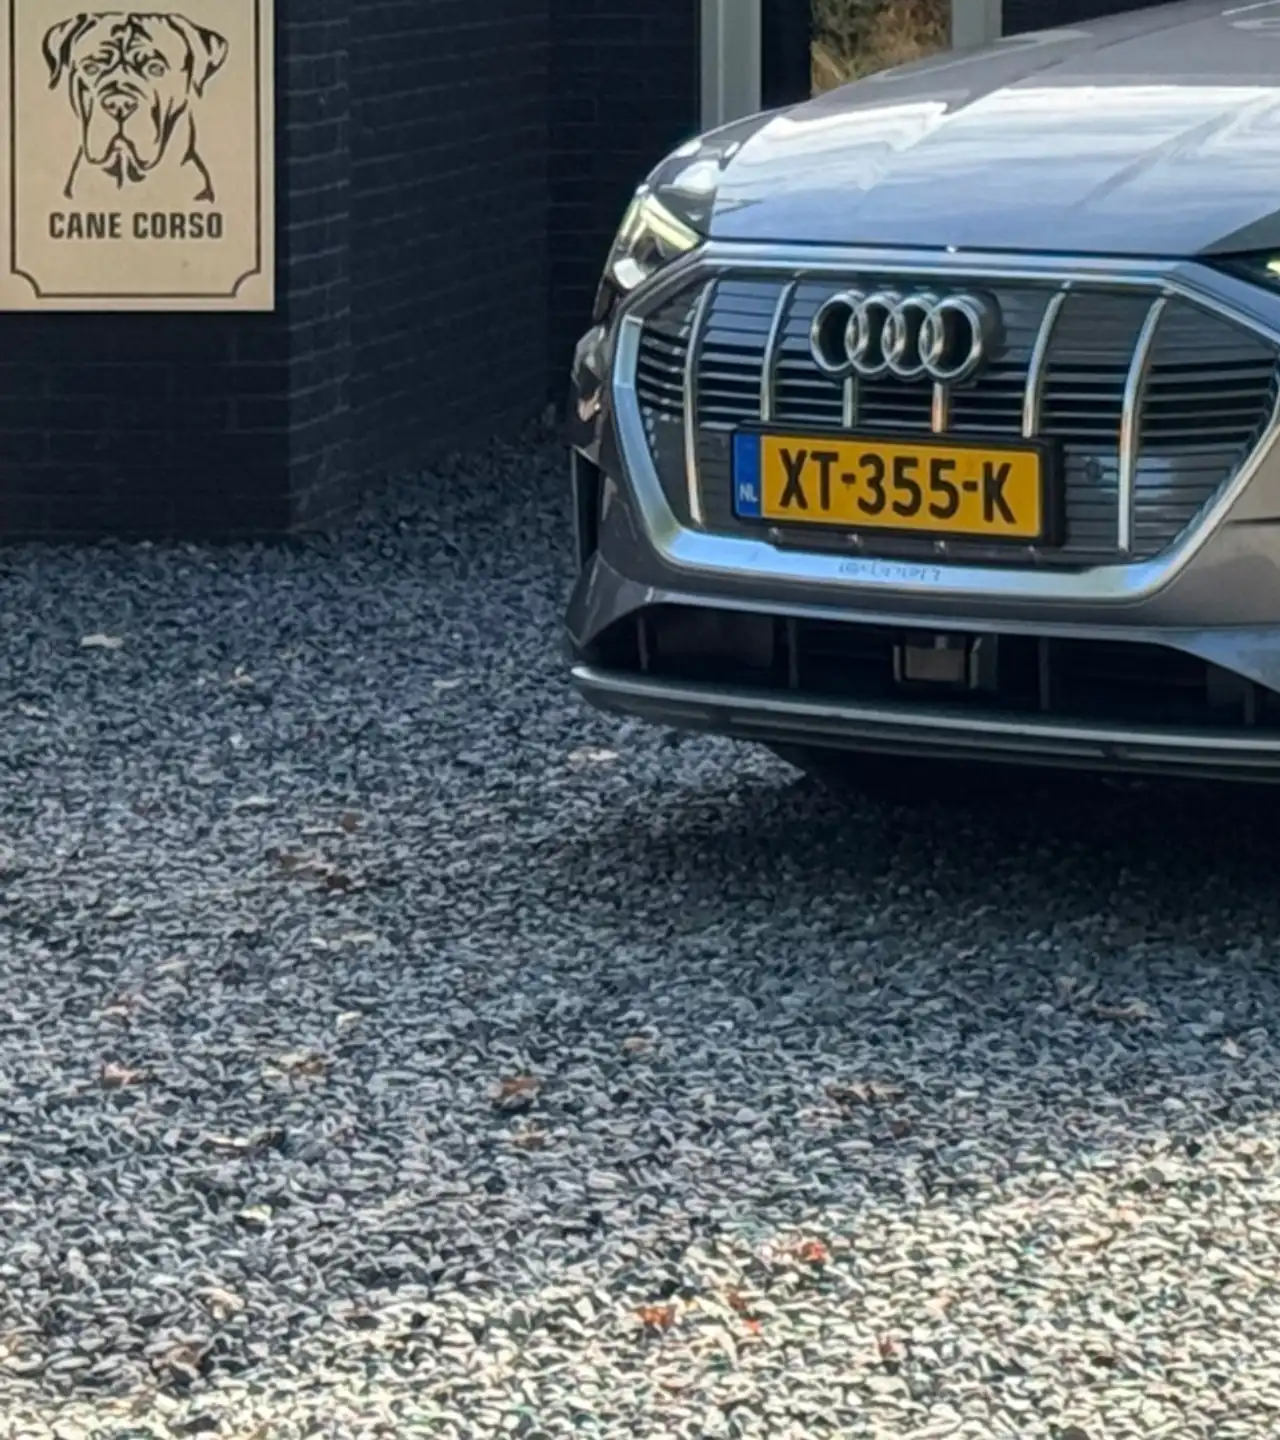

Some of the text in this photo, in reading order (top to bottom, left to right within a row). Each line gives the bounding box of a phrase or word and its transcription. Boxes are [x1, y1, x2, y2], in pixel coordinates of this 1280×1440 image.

[50, 212, 223, 239] CANE CORSO
[739, 483, 759, 503] NL
[778, 448, 1017, 525] XT-355-K
